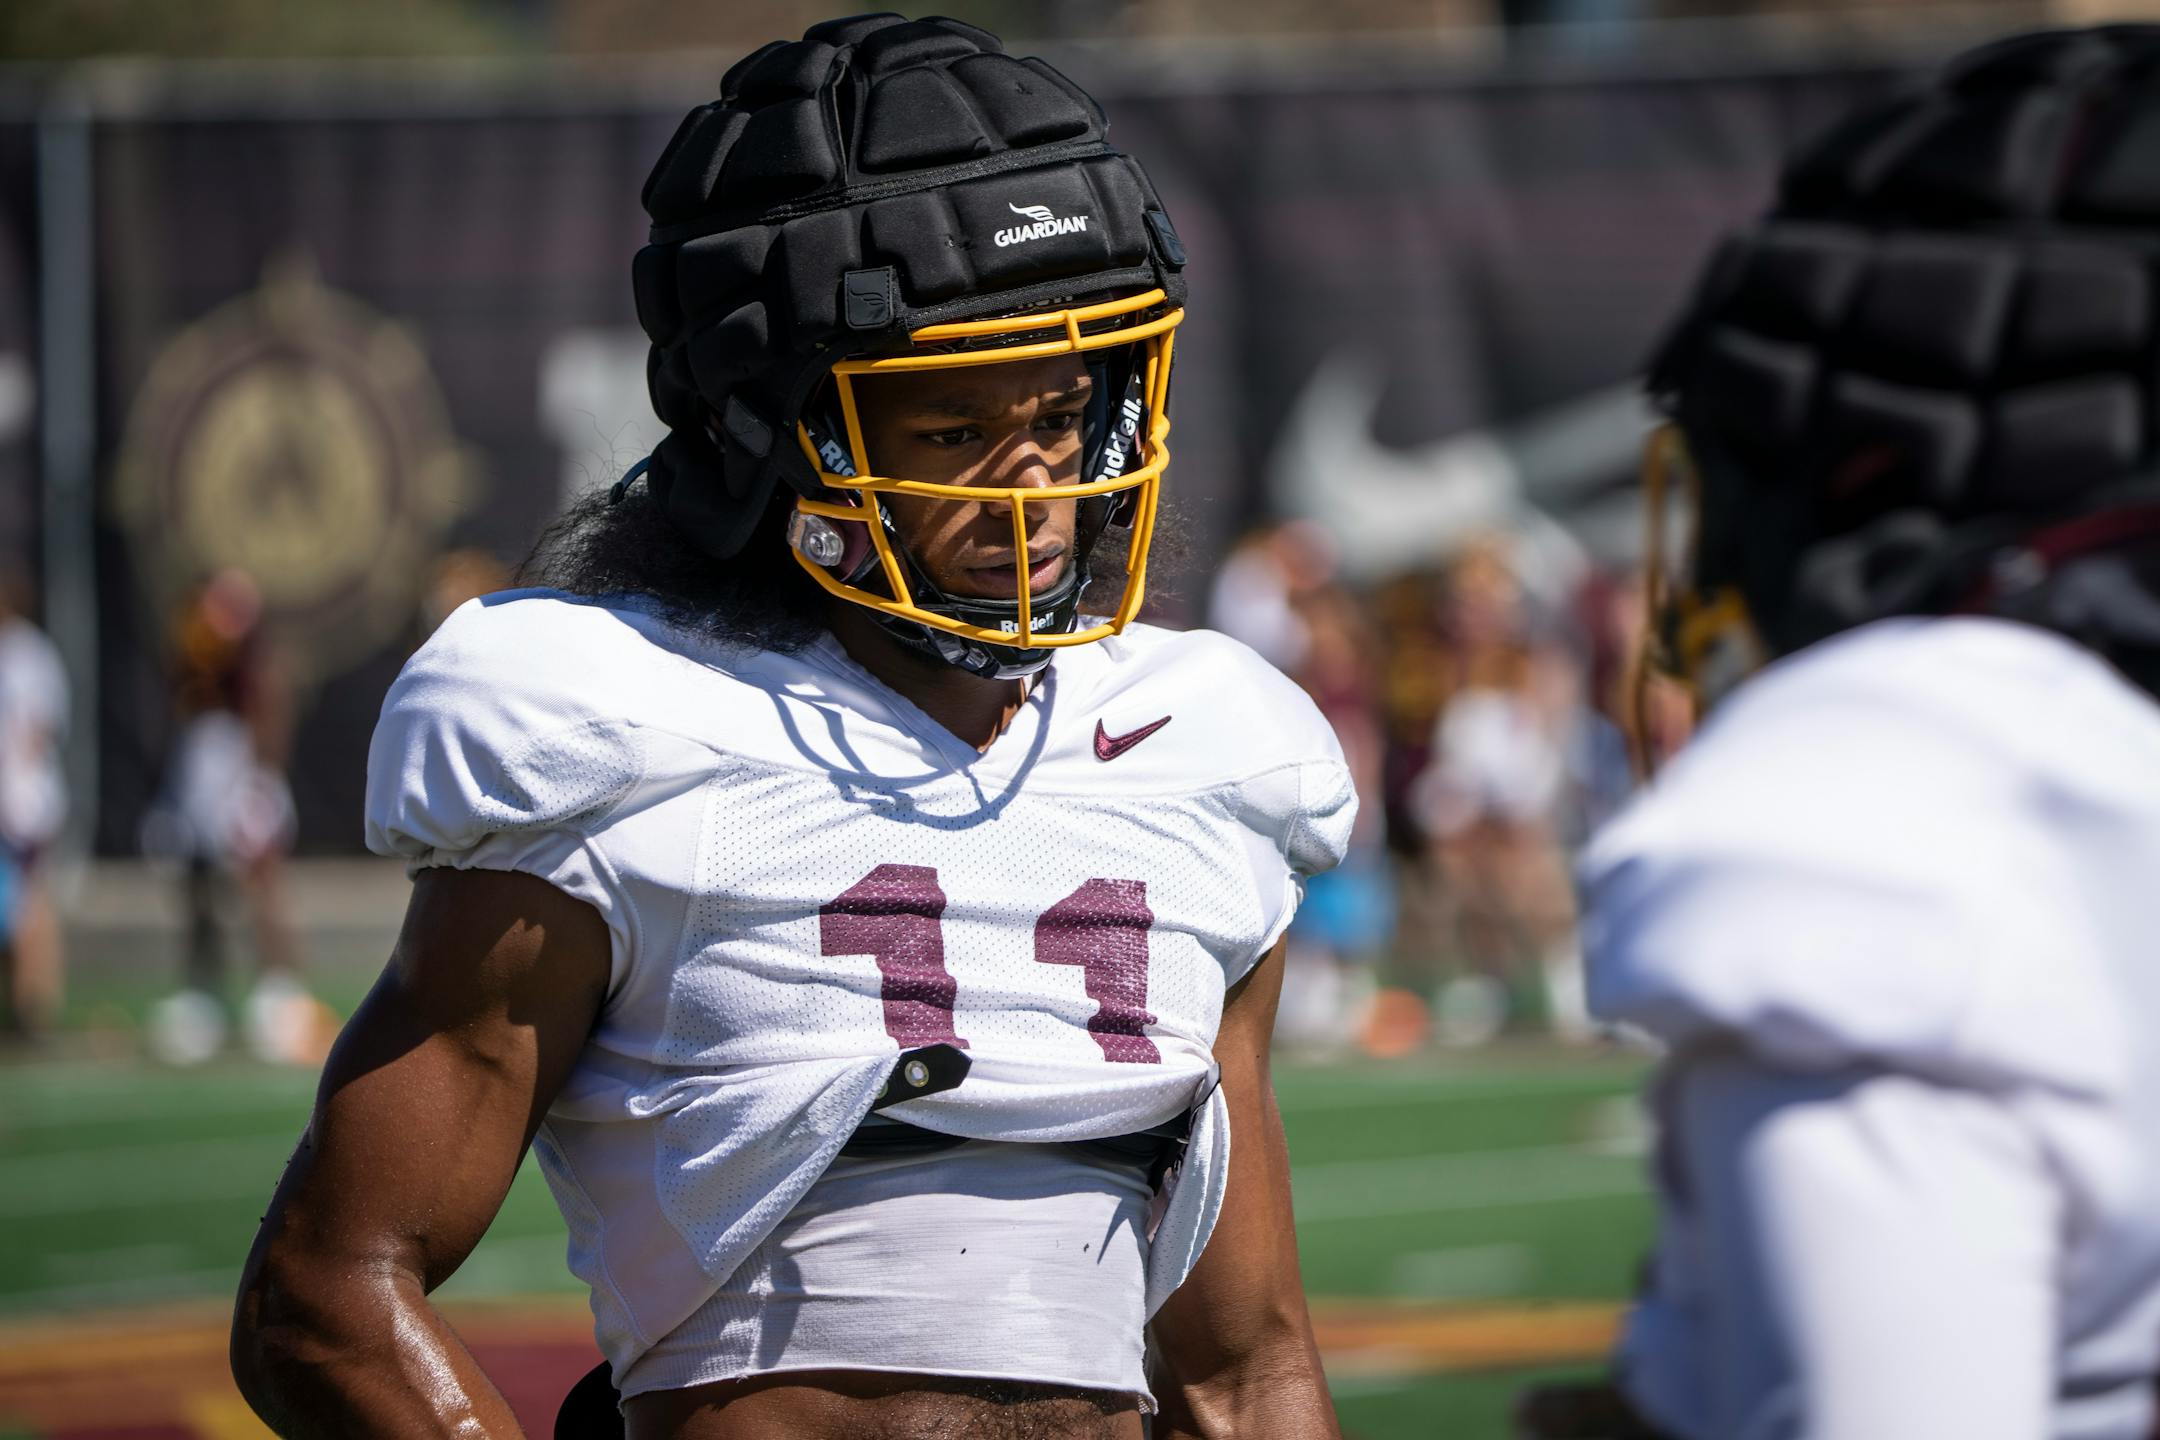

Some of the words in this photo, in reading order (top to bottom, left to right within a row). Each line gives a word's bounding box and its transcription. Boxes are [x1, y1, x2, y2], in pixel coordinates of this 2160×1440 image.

[993, 215, 1088, 248] GUARDIAN
[1000, 612, 1054, 634] Ridell
[819, 863, 1162, 1064] 11
